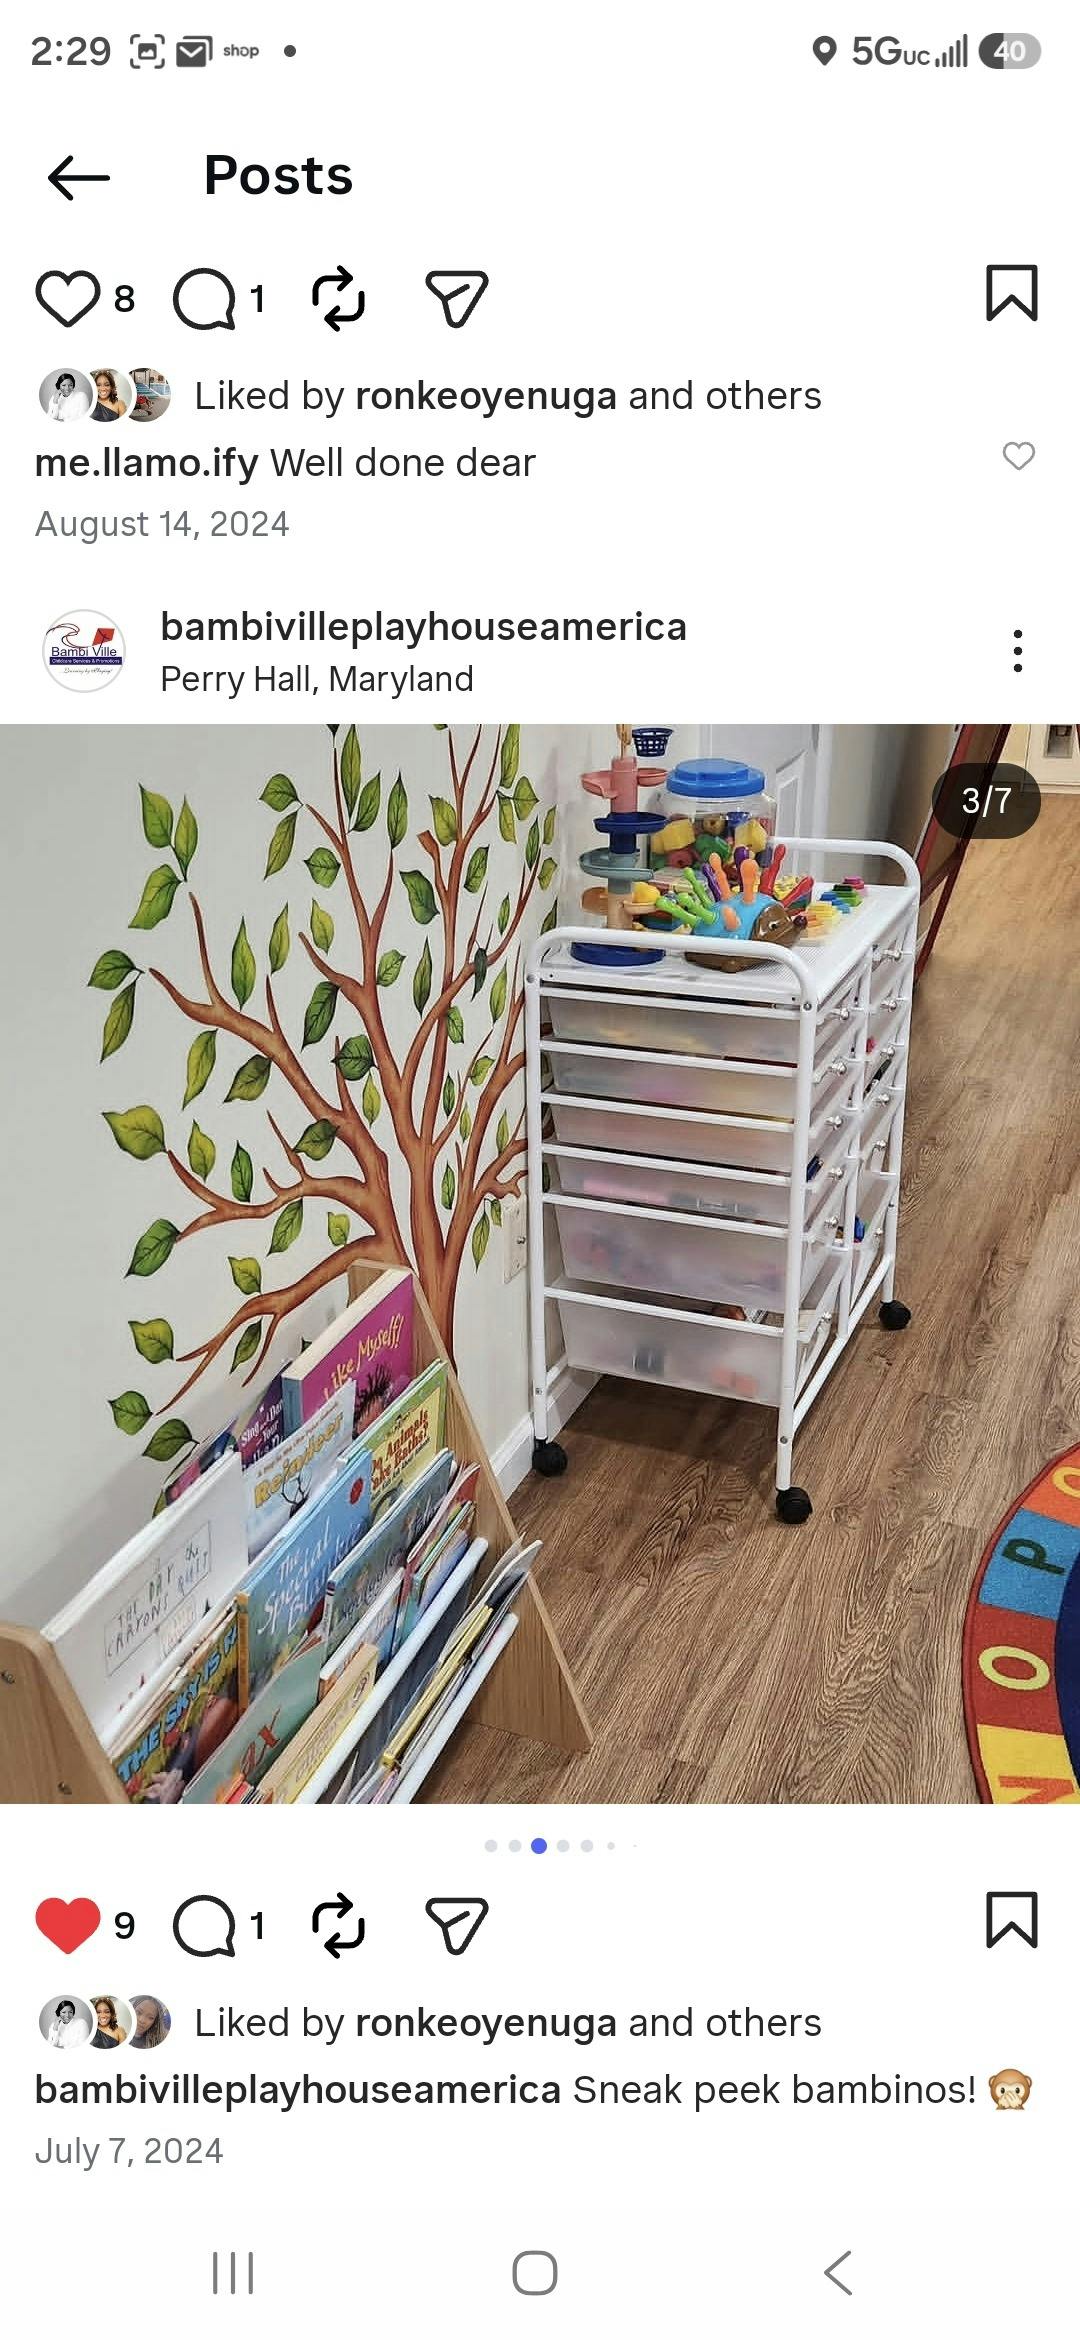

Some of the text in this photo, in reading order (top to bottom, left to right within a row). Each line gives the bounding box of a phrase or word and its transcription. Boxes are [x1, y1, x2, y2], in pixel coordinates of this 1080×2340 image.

[31, 36, 111, 67] 2:29
[223, 43, 260, 60] shop
[993, 40, 1026, 62] 40
[206, 154, 353, 196] Posts
[114, 284, 135, 313] 8
[250, 284, 263, 313] 1
[196, 379, 822, 418] Liked by ronkeoyenuga and others
[35, 446, 537, 486] me.llamo.ify Well done dear
[34, 510, 290, 545] August 14, 2024
[161, 610, 686, 650] bambivilleplayhouseamerica
[51, 646, 117, 657] Bambi Ville
[162, 664, 473, 699] Perry Hall, Maryland
[356, 1313, 405, 1373] Myself!
[116, 1720, 161, 1784] THE
[164, 1672, 202, 1733] SKY
[114, 1911, 136, 1940] 9
[250, 1911, 263, 1940] 1
[196, 2006, 822, 2045] Liked by ronkeoyenuga and others
[35, 2073, 976, 2113] bambivilleplayhouseamerica Sneak peek bambinos!
[35, 2136, 224, 2172] July 7, 2024
